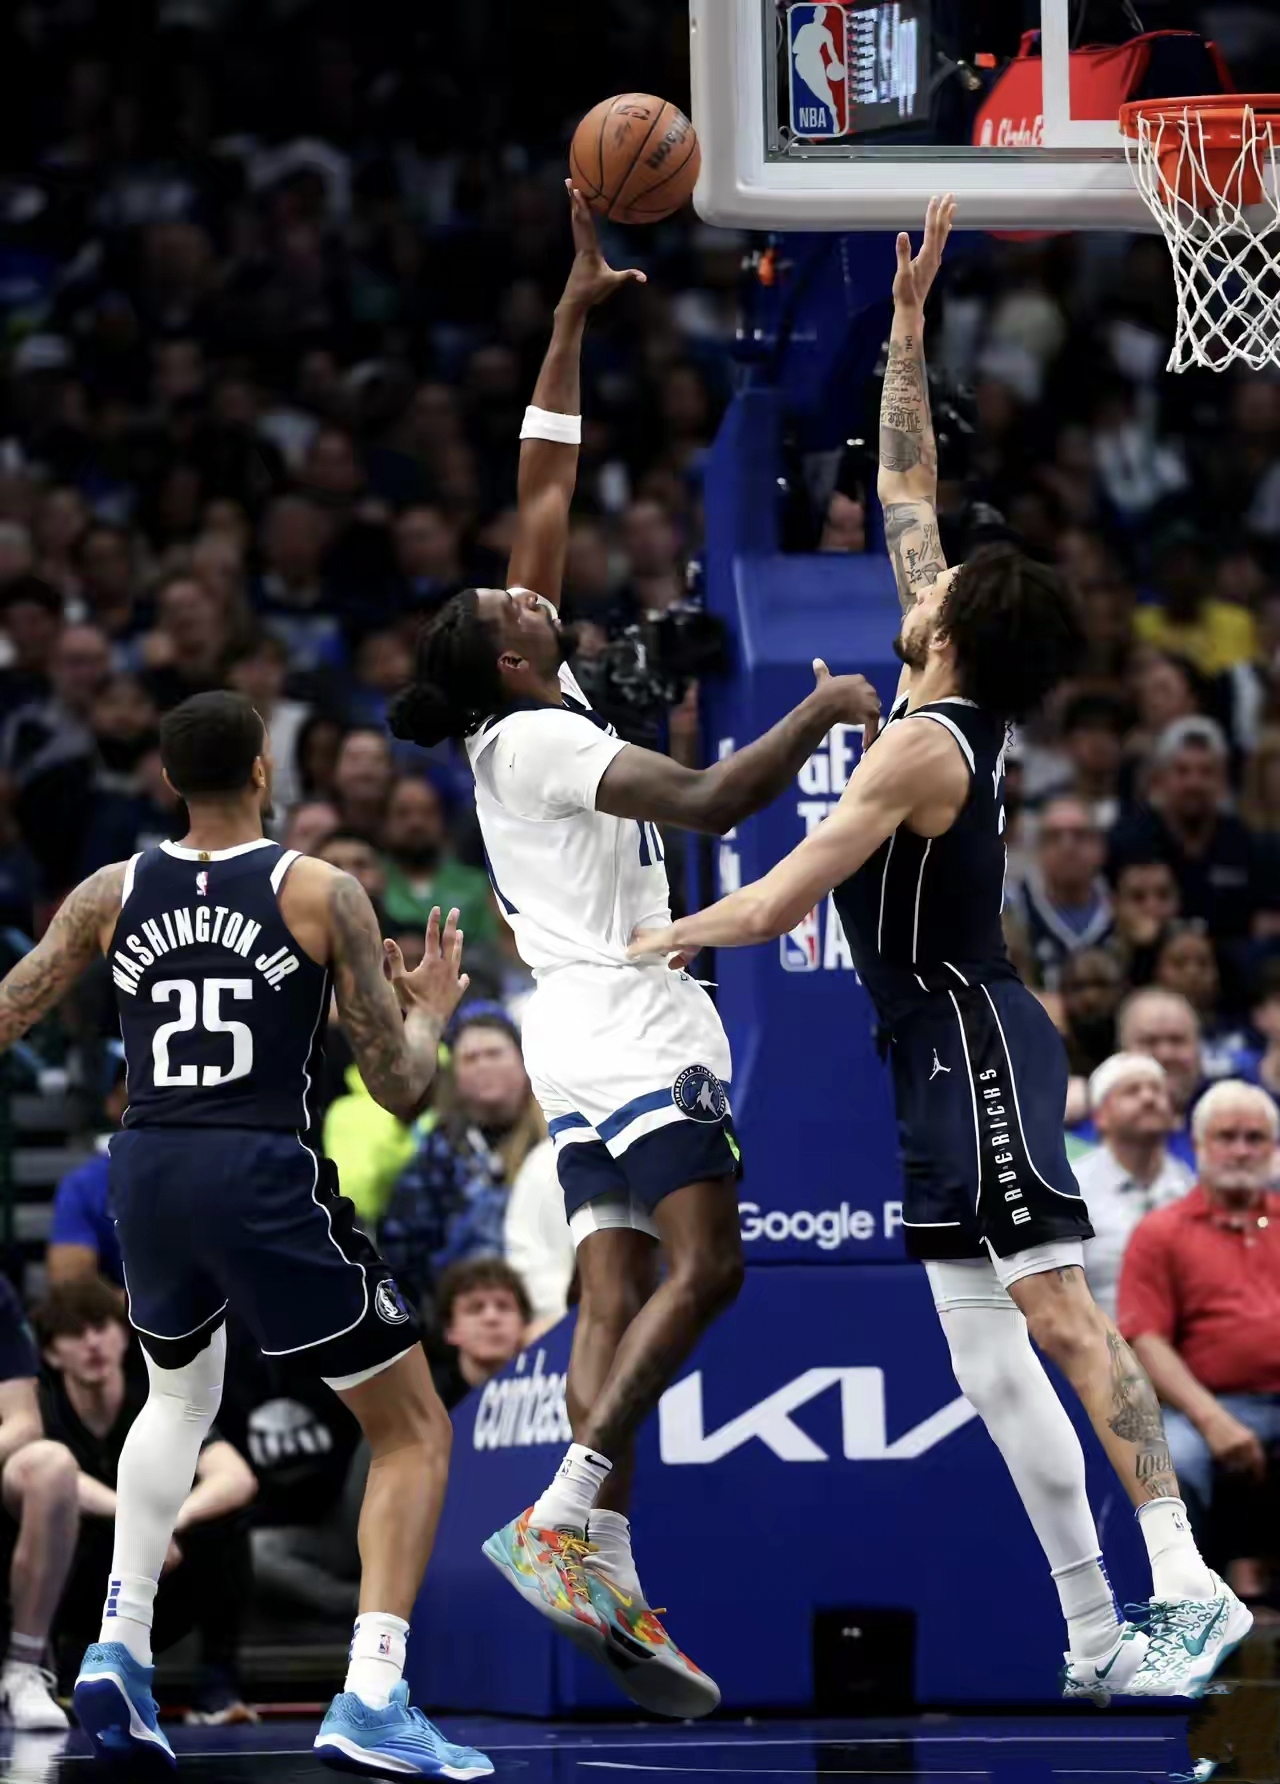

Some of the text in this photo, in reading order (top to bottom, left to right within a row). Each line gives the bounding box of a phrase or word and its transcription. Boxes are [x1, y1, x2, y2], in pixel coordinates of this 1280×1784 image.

[799, 107, 827, 128] NBA
[112, 905, 300, 996] WASHINGTON JR.
[151, 978, 253, 1087] 25
[979, 1068, 1032, 1226] MAVERICKS
[737, 1201, 875, 1251] Google
[473, 1347, 574, 1452] coinbas
